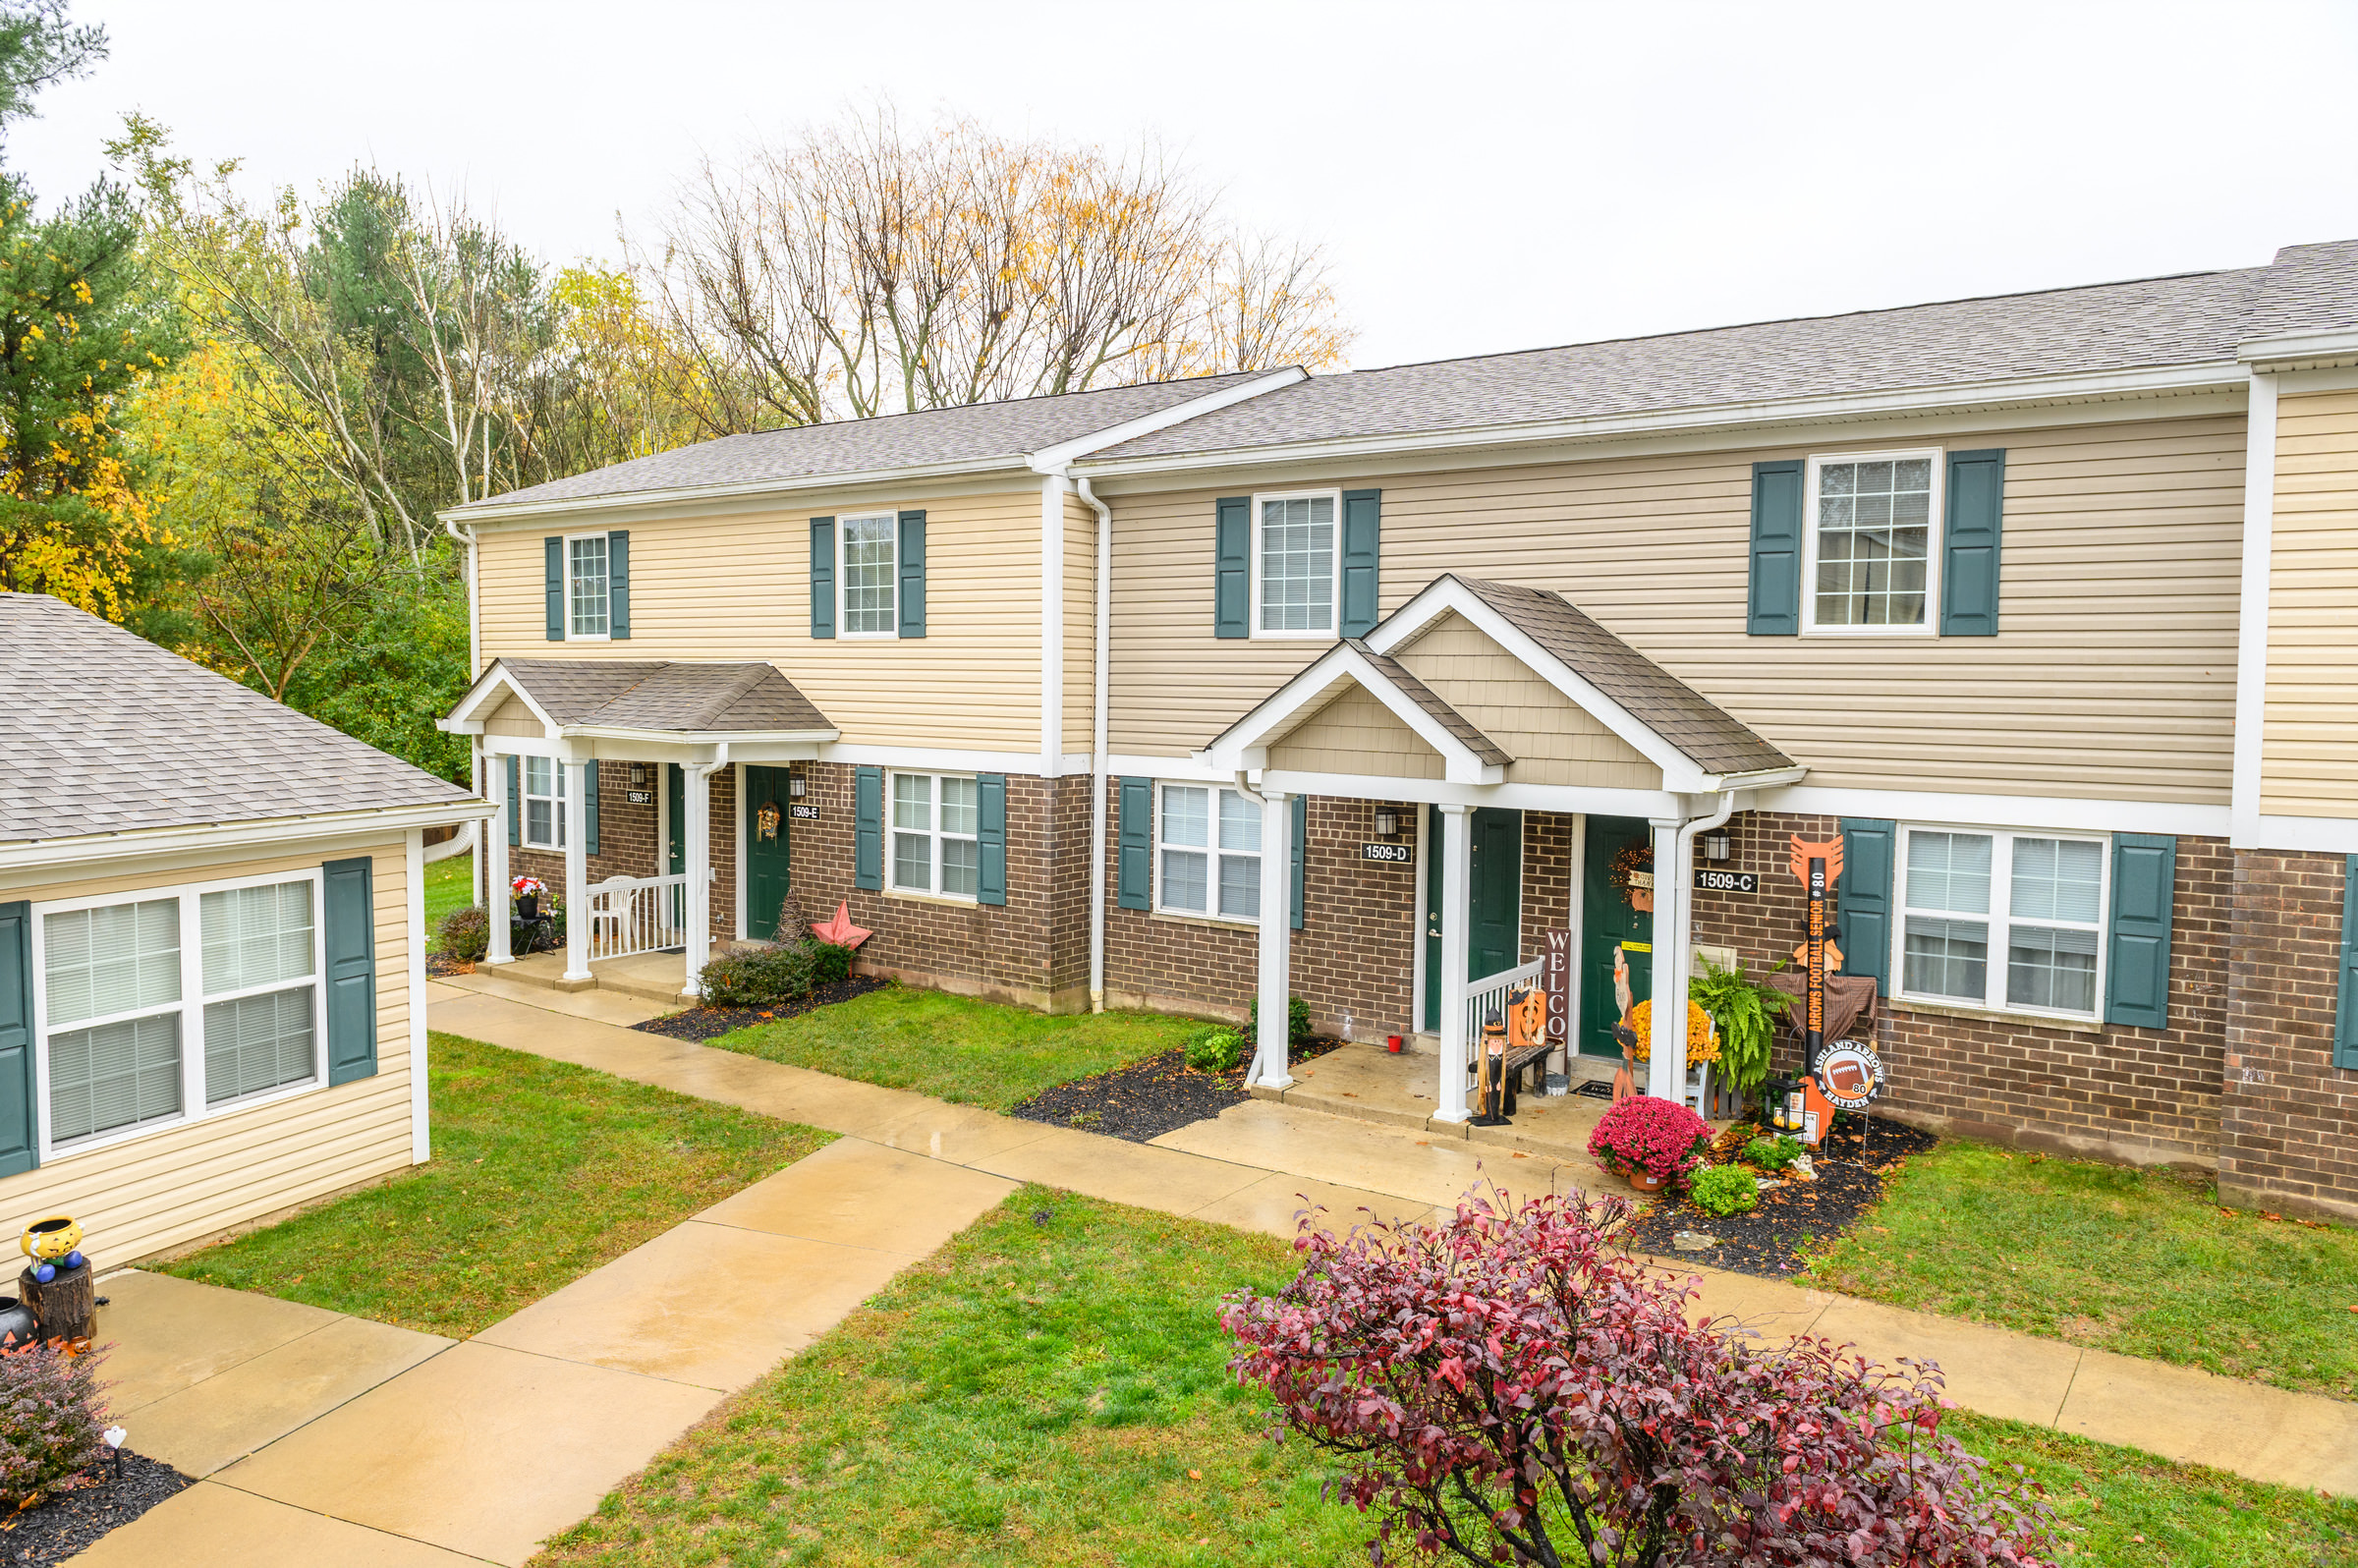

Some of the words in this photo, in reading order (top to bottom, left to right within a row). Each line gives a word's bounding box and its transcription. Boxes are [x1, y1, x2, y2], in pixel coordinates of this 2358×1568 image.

[629, 792, 649, 804] 1509-F
[792, 806, 817, 818] 1509-E
[1366, 845, 1406, 861] 1509-D
[1700, 871, 1752, 891] 1509-C
[1812, 872, 1825, 887] 80
[1810, 900, 1824, 936] SENIOR
[1809, 938, 1824, 988] FOOTBALL
[1547, 931, 1570, 1041] WELCO
[1809, 990, 1823, 1034] ARROWS
[1814, 1041, 1853, 1074] ASHLAND
[1853, 1043, 1883, 1084] ARROWS
[1852, 1084, 1868, 1094] 80
[1824, 1091, 1870, 1108] HAYDEN
